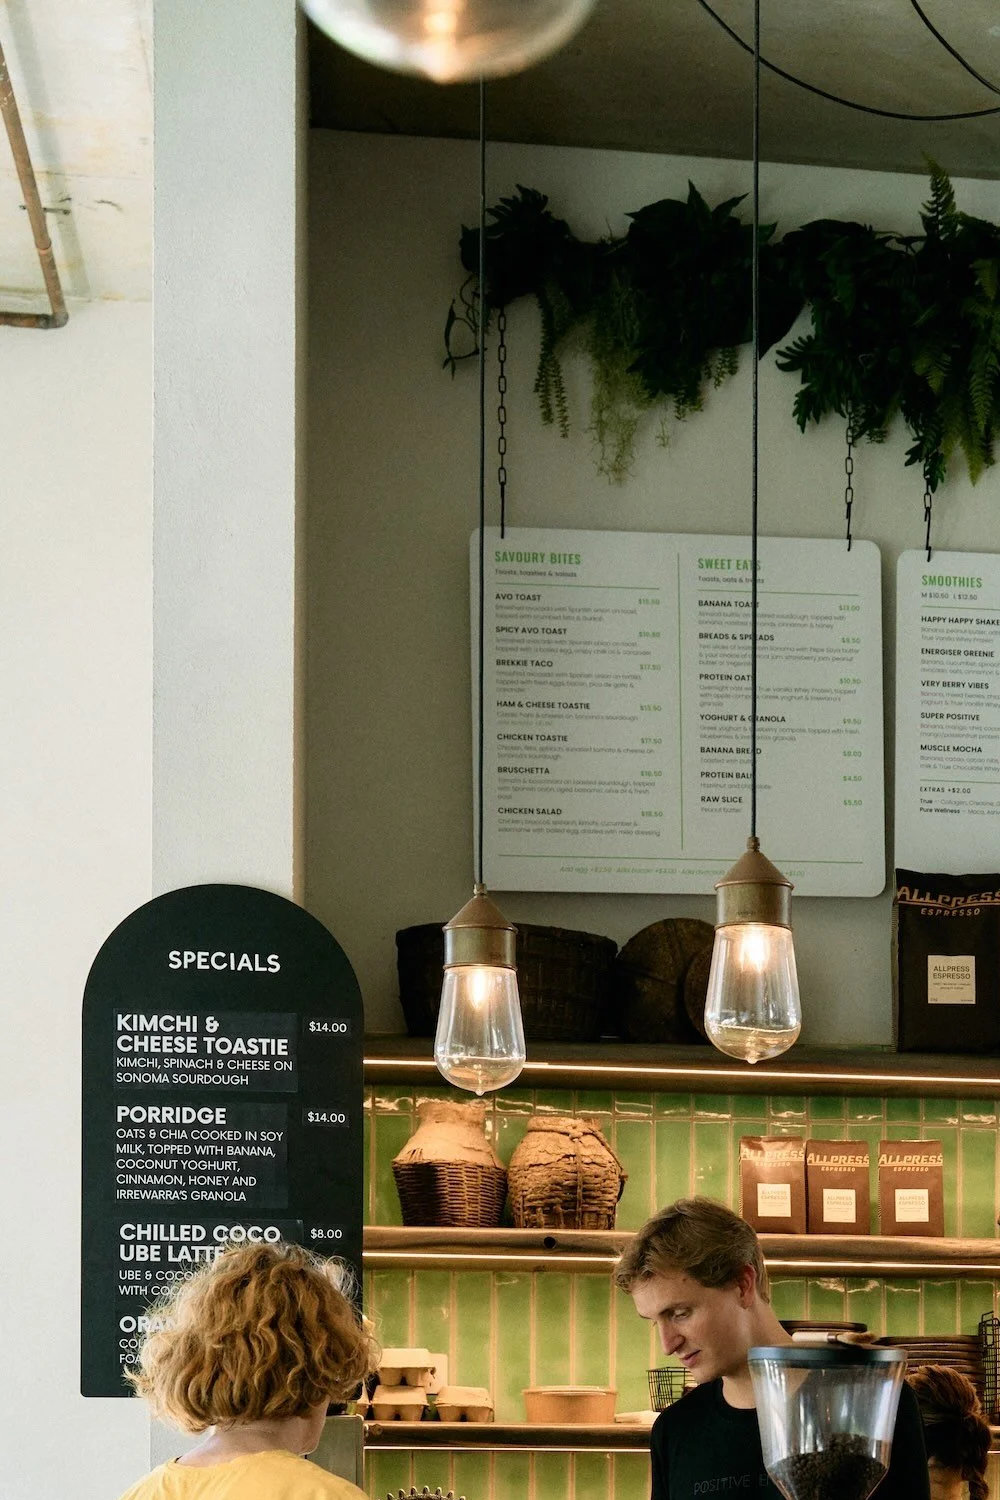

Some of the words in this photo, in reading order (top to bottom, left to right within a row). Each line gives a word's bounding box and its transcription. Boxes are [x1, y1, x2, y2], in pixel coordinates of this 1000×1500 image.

[494, 550, 545, 563] SAVOURY
[549, 552, 581, 564] BITES
[698, 558, 732, 570] SWEET
[921, 574, 982, 588] SMOOTHIES
[494, 592, 513, 600] AVO
[514, 592, 541, 601] TOAST
[975, 618, 1000, 626] SHAKE
[495, 625, 520, 633] SPICY
[520, 626, 539, 634] AVO
[540, 626, 567, 635] TOAST
[920, 647, 962, 656] ENERGISER
[962, 649, 994, 658] GREENIE
[495, 658, 528, 667] BREKKIE
[530, 659, 553, 667] TACO
[967, 681, 989, 689] VIBES
[496, 699, 516, 707] HAM
[516, 700, 524, 708] &
[524, 700, 555, 709] CHEESE
[557, 701, 590, 709] TOASTIE
[920, 711, 945, 719] SUPER
[945, 712, 980, 721] POSITIVE
[496, 732, 533, 741] CHICKEN
[534, 733, 568, 742] TOASTIE
[919, 744, 950, 752] MUSCLE
[951, 745, 982, 753] MOCHA
[496, 765, 550, 774] BRUSCHETTA
[720, 795, 742, 803] SLICE
[496, 806, 534, 814] CHICKEN
[535, 807, 562, 815] SALAD
[920, 908, 981, 916] ESPRESSO
[168, 950, 280, 973] SPECIALS
[116, 1013, 197, 1032] KIMCHI
[205, 1015, 219, 1033] &
[308, 1021, 347, 1032] $14.00
[116, 1035, 197, 1053] CHEESE
[202, 1036, 288, 1055] TOASTIE
[116, 1056, 161, 1068] KIMCHI,
[163, 1057, 213, 1069] SPINACH
[216, 1059, 224, 1069] &
[226, 1059, 270, 1070] CHEESE
[273, 1060, 292, 1071] ON
[116, 1072, 169, 1083] SONOMA
[171, 1073, 248, 1085] SOURDOUGH
[116, 1105, 226, 1124] PORRIDGE
[307, 1111, 345, 1123] $14.00
[115, 1128, 146, 1138] OATS
[148, 1128, 156, 1139] &
[159, 1128, 188, 1139] CHIA
[190, 1129, 242, 1140] COOKED
[244, 1130, 257, 1141] IN
[259, 1130, 283, 1141] SOY
[116, 1143, 145, 1155] MILK,
[146, 1143, 191, 1154] TOPPED
[193, 1144, 223, 1155] WITH
[226, 1145, 275, 1156] BANANA,
[741, 1148, 804, 1159] ALLPRESS
[115, 1158, 178, 1169] COCONUT
[180, 1159, 240, 1170] YOGHURT,
[807, 1153, 869, 1164] ALLPRESS
[879, 1153, 944, 1165] ALLPRESS
[115, 1173, 186, 1185] CINNAMON,
[188, 1175, 229, 1186] HONEY
[231, 1176, 256, 1186] AND
[116, 1189, 187, 1200] IRREWARRA'S
[190, 1190, 246, 1201] GRANOLA
[119, 1223, 206, 1241] CHILLED
[212, 1225, 280, 1243] COCO
[310, 1228, 342, 1239] $8.00
[120, 1244, 161, 1262] UBE
[119, 1270, 141, 1280] UBE
[145, 1270, 152, 1280] &
[119, 1285, 148, 1295] WITH
